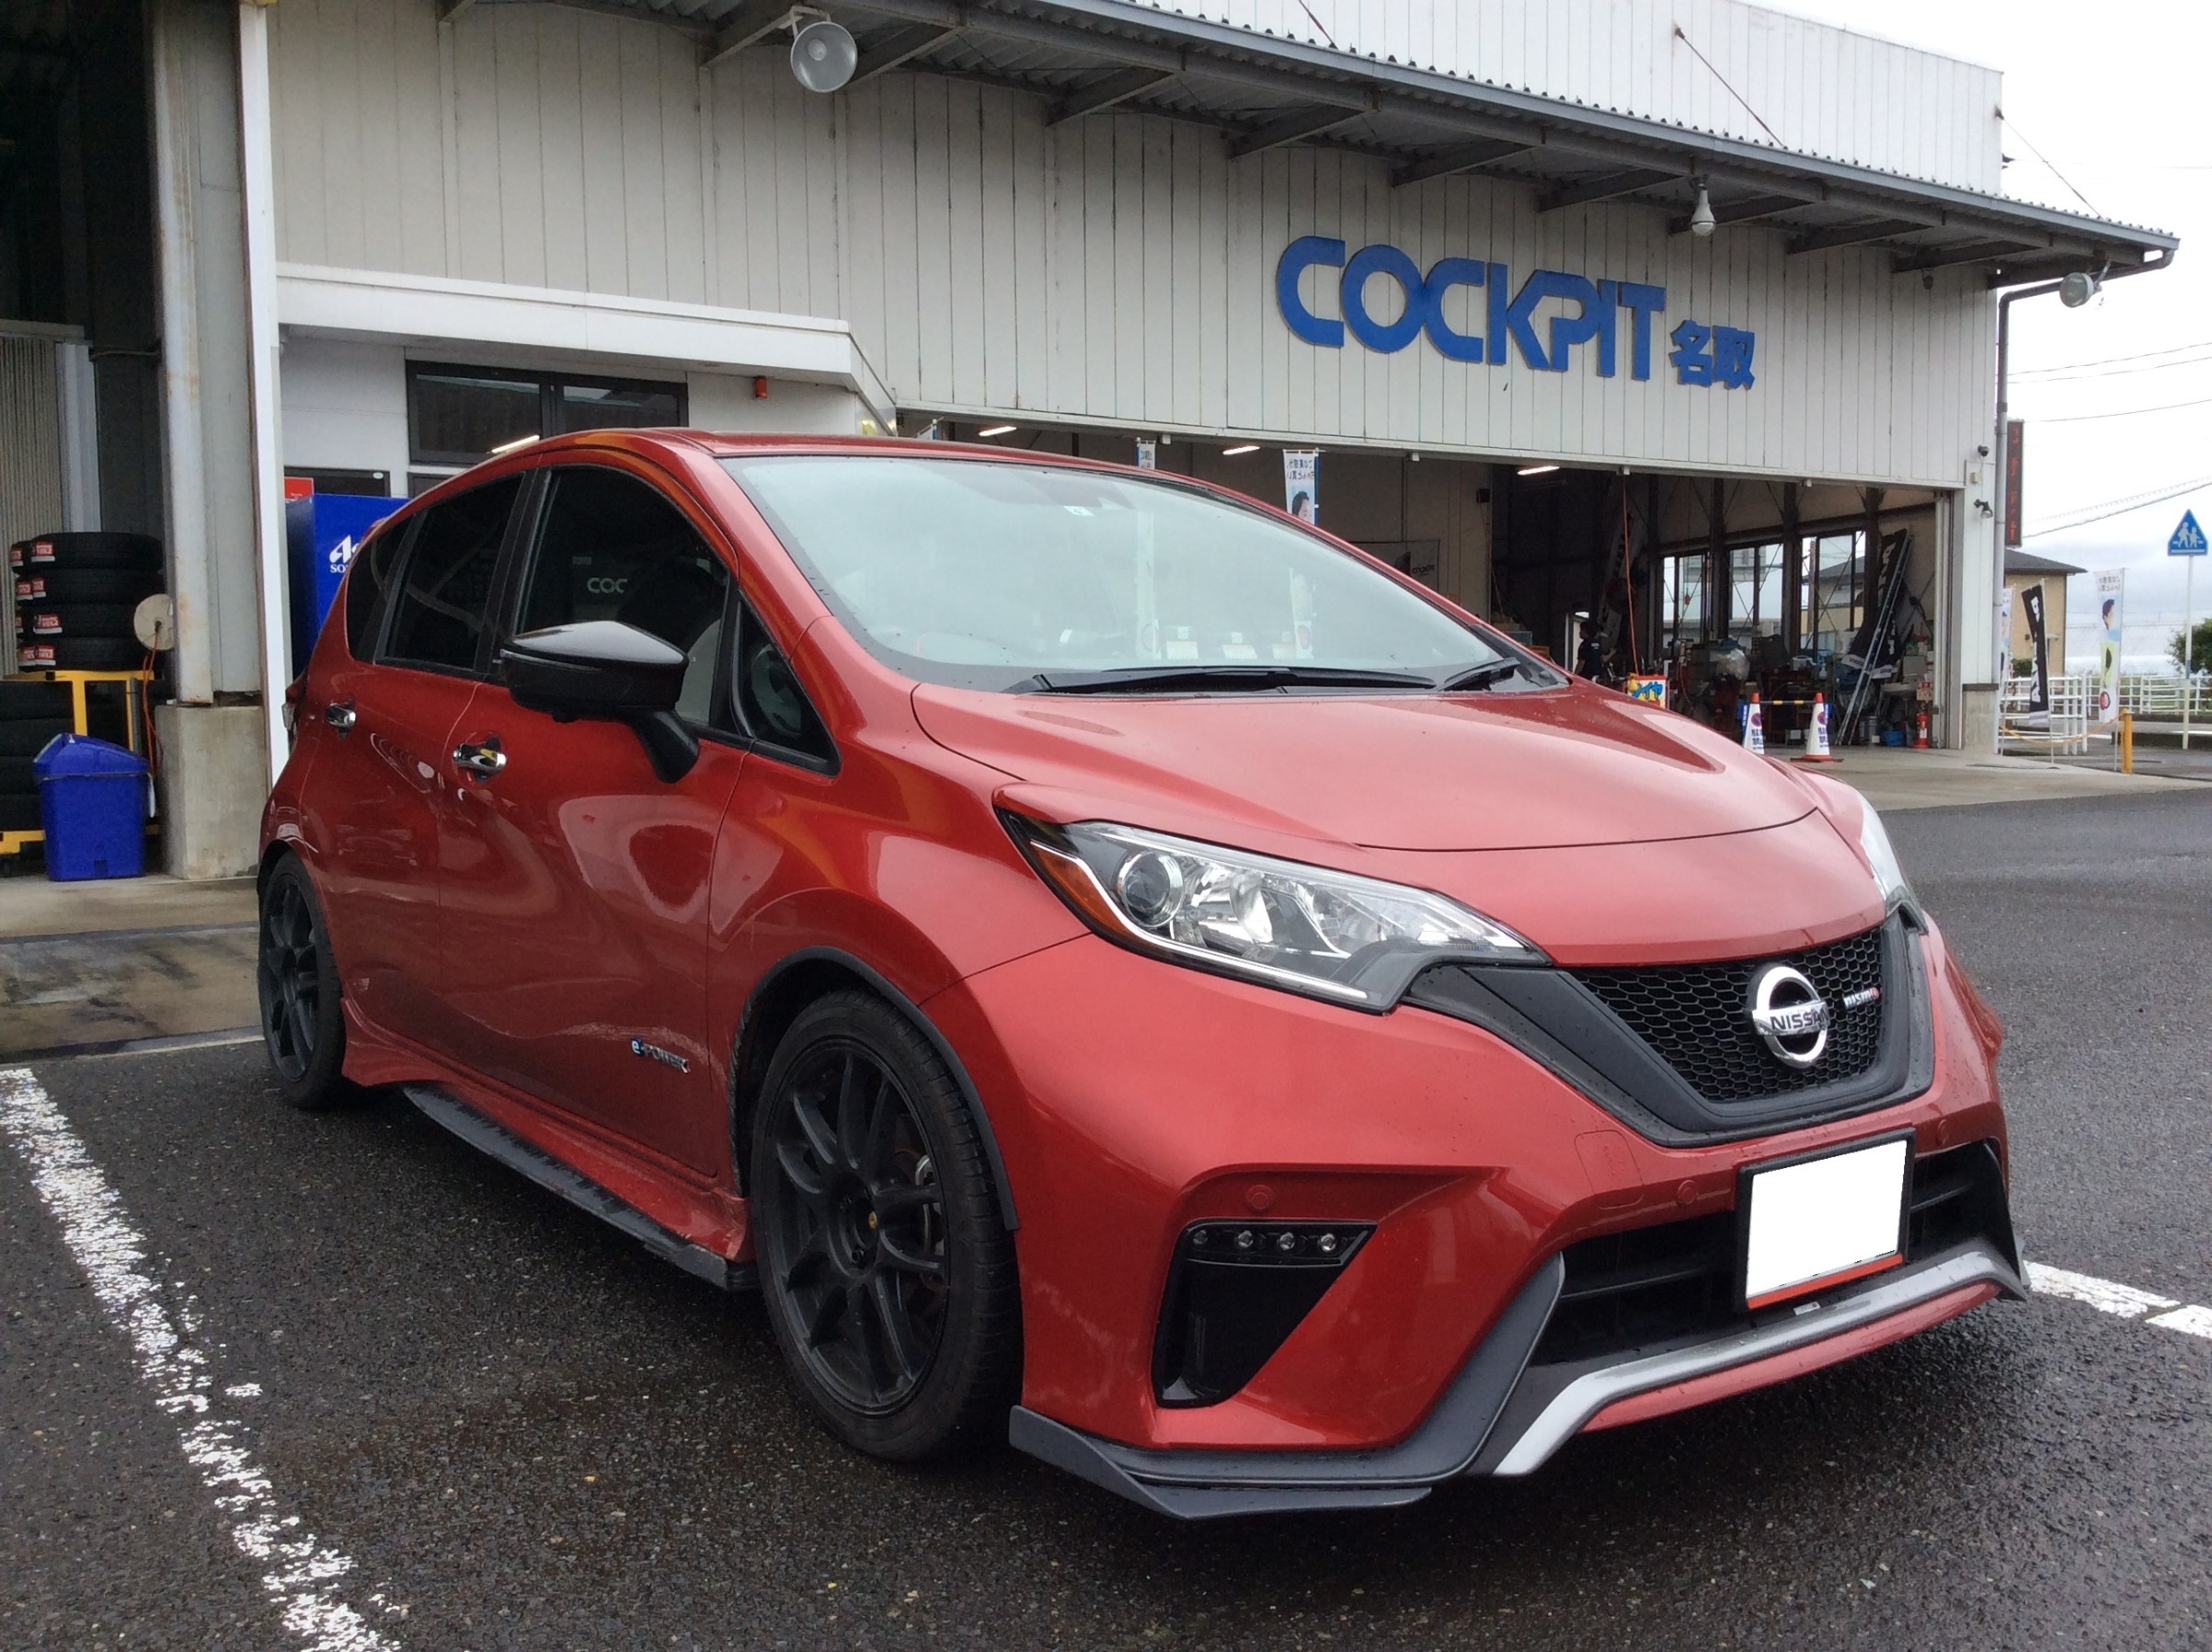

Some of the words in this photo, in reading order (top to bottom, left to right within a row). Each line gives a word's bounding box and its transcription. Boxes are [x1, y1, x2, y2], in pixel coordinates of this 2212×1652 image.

[1277, 235, 1666, 380] COCKPIT
[1669, 319, 1755, 389] 名取
[330, 564, 349, 574] SO
[1844, 987, 1879, 1008] nismo
[1771, 1006, 1828, 1030] NISSAN
[631, 1039, 691, 1073] e-POWER
